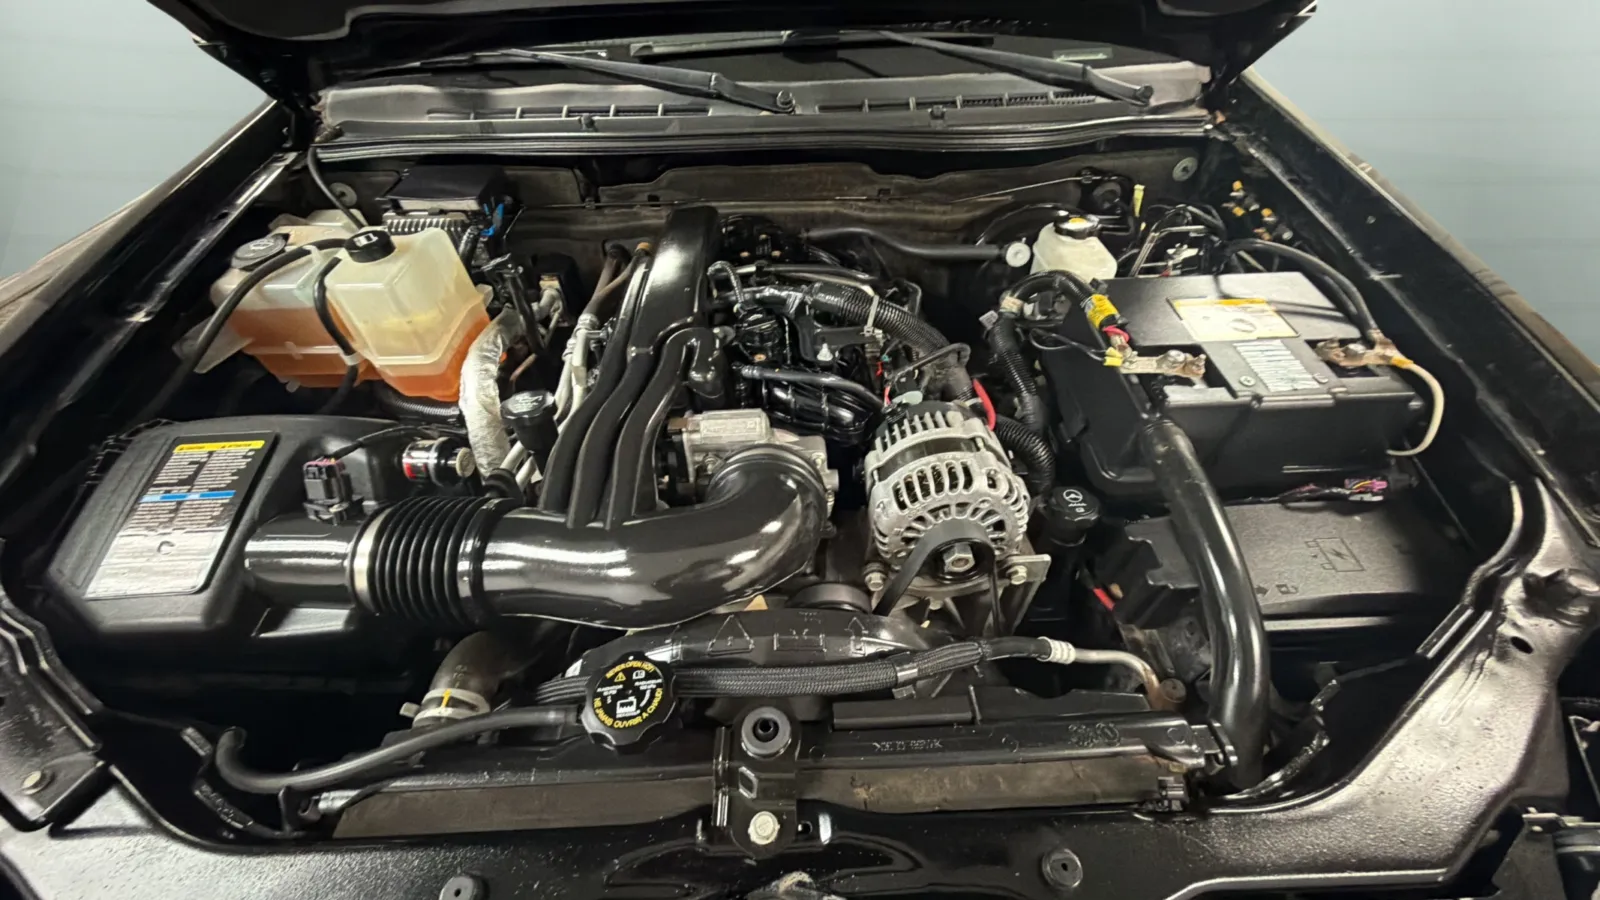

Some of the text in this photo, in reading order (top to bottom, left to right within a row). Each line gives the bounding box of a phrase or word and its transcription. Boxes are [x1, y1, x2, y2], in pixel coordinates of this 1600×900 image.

[593, 697, 602, 708] NE
[595, 708, 614, 726] JAMAIS
[614, 716, 643, 728] OUVRIR
